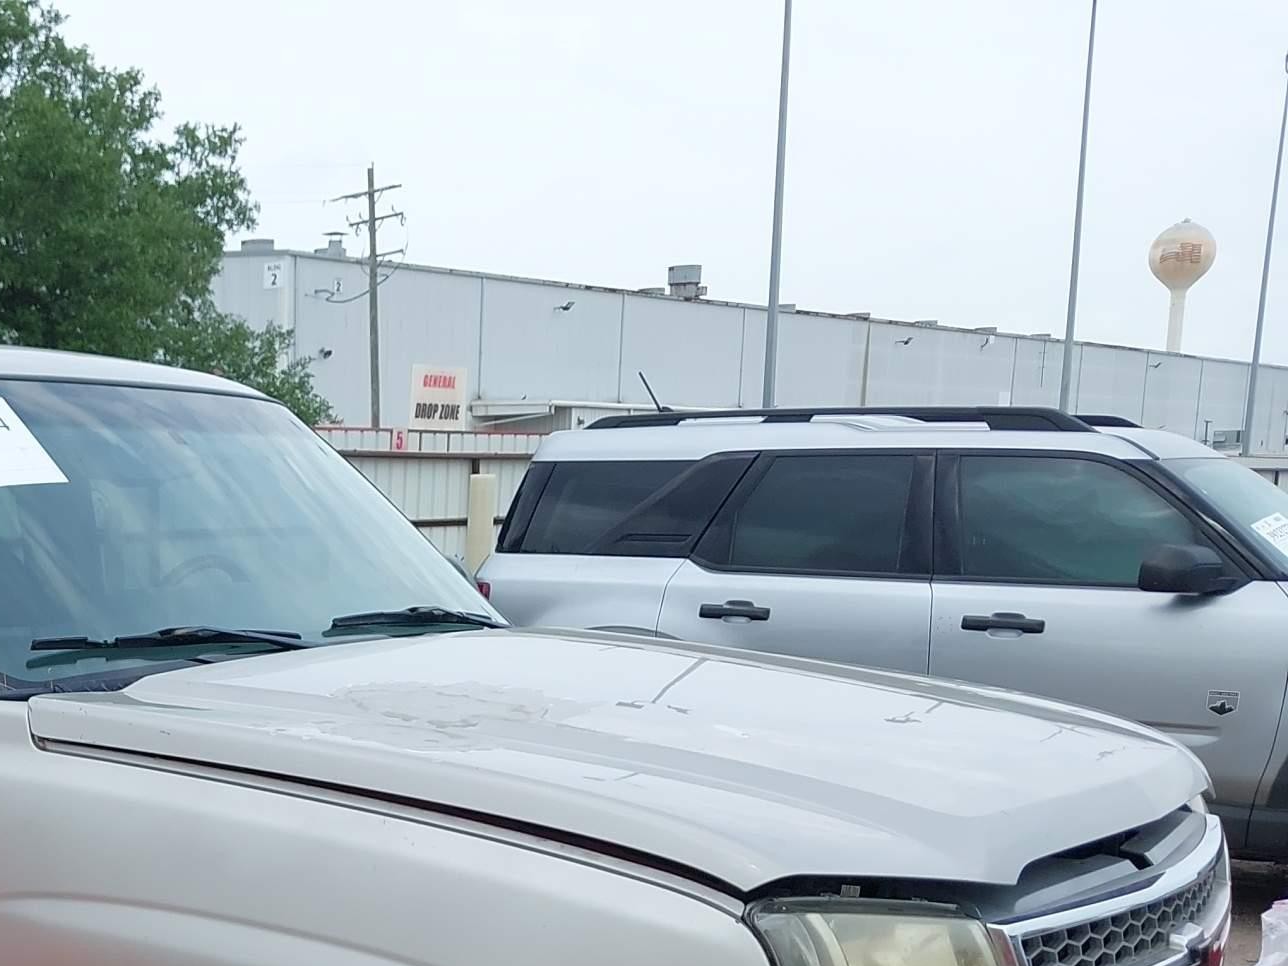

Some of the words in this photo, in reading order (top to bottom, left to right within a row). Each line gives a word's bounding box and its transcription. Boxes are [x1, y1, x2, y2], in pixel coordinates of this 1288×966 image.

[271, 273, 277, 286] 2
[336, 281, 342, 292] 2
[423, 374, 456, 389] GENERAL
[415, 402, 439, 420] DROP
[439, 404, 461, 421] ZONE
[396, 431, 403, 450] 5
